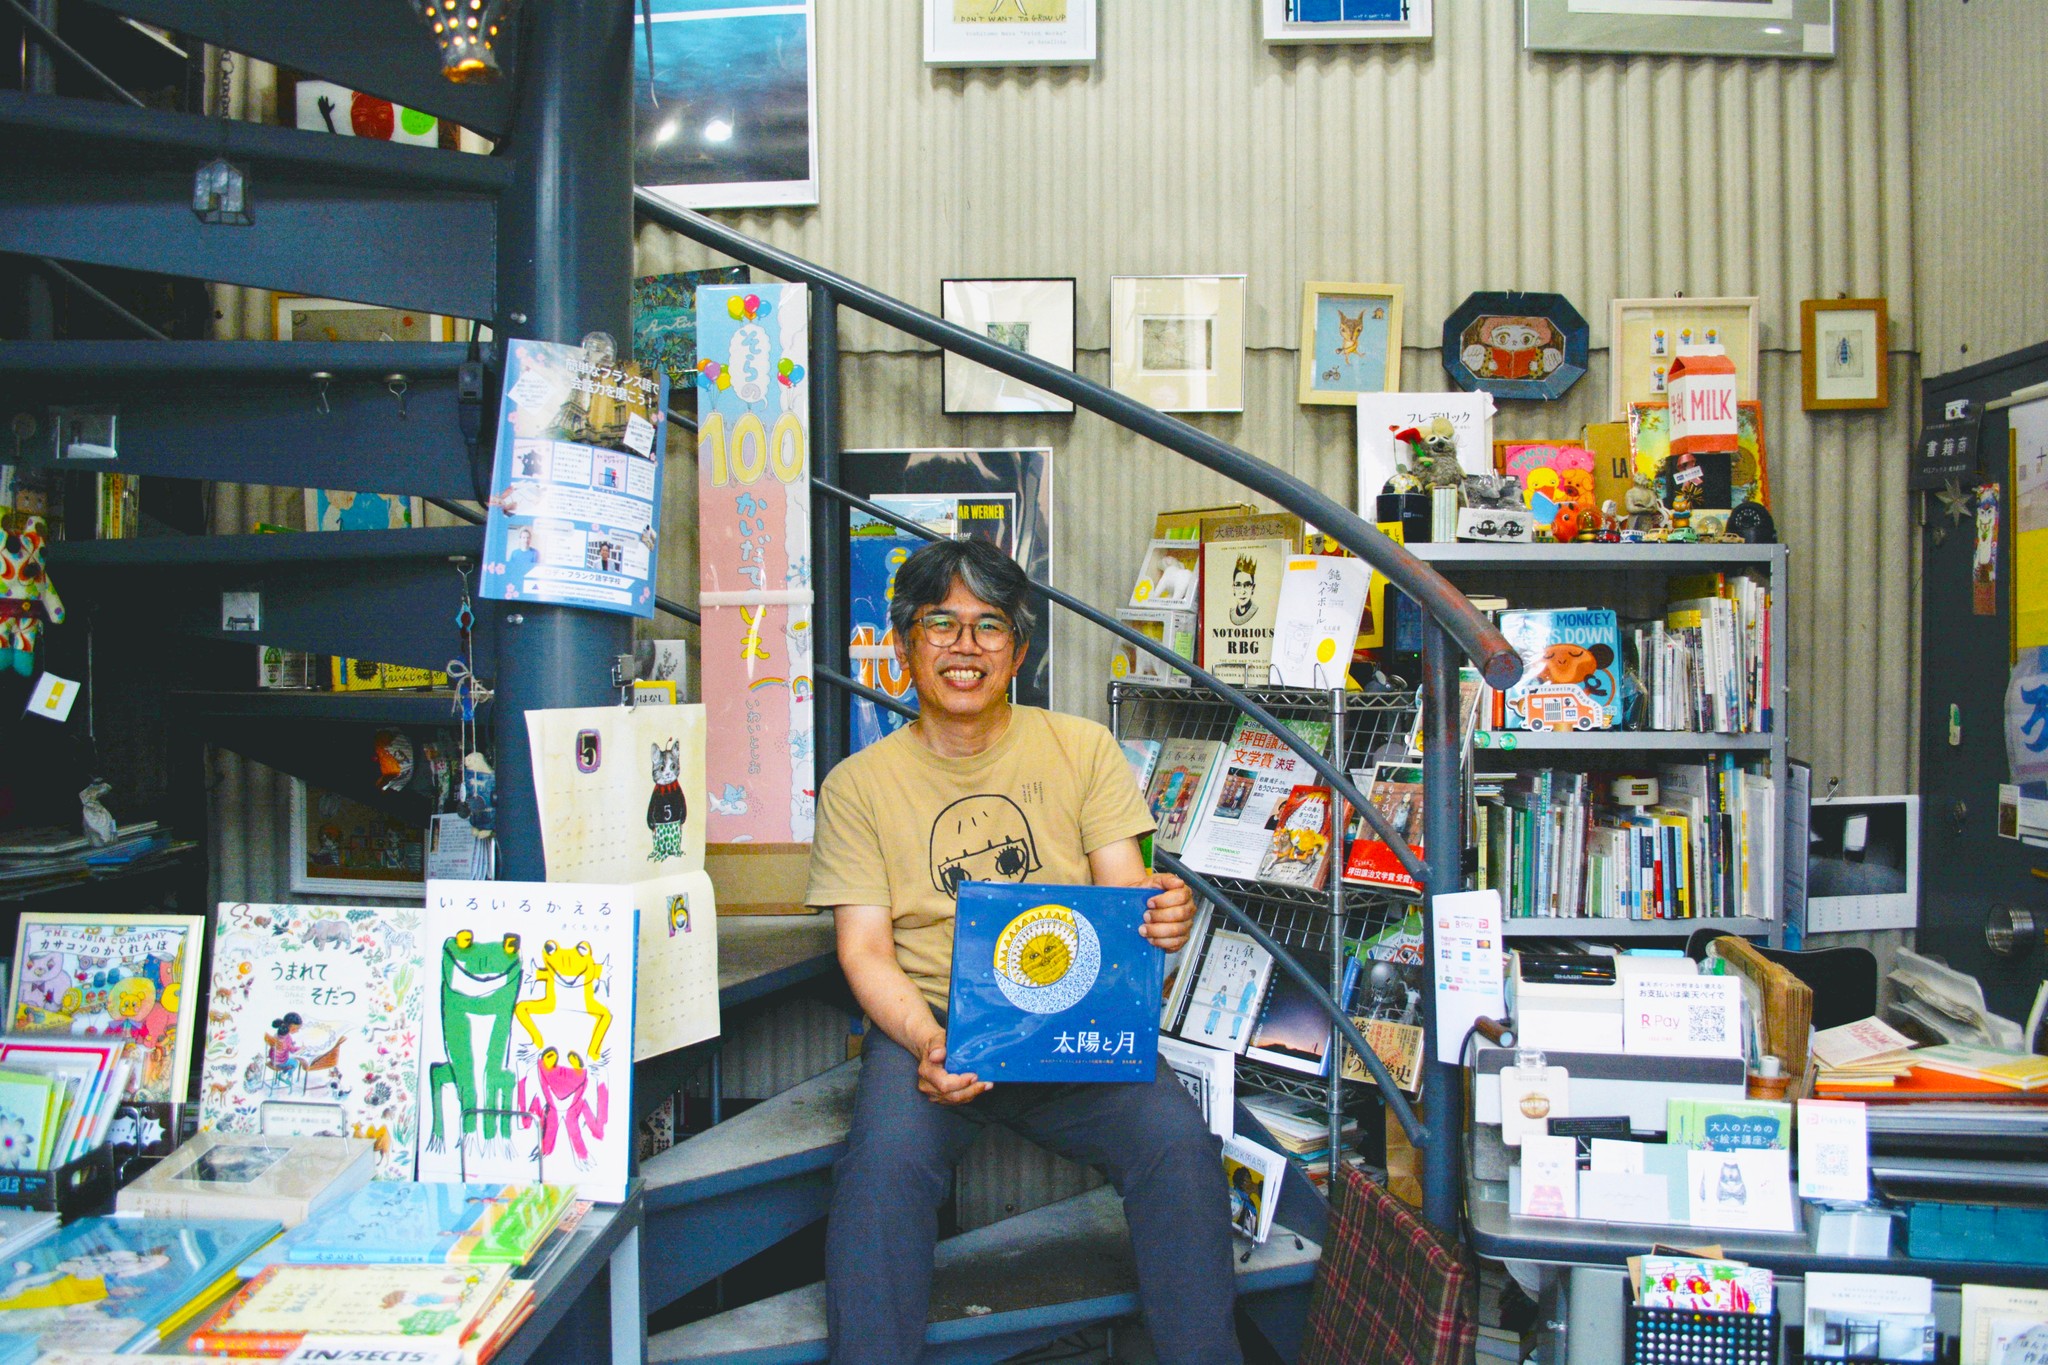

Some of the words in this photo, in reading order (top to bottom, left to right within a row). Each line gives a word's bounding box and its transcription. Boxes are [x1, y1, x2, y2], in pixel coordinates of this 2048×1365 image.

[1031, 14, 1053, 22] GROW
[739, 330, 762, 398] そらの
[565, 358, 660, 396] 簡単なフランス語で
[1691, 389, 1733, 421] MILK
[698, 411, 805, 488] 100
[1612, 457, 1628, 478] LA
[971, 505, 1005, 519] WERNER
[1556, 612, 1611, 627] MONKEY
[1213, 628, 1274, 638] NOTORIOUS
[1565, 627, 1614, 644] DOWN
[1227, 641, 1259, 654] RBG
[580, 732, 597, 769] 5
[1231, 748, 1275, 768] 文学賞
[1274, 757, 1296, 772] 決定
[663, 805, 671, 820] 5
[440, 896, 613, 916] いろいろかえる
[670, 896, 689, 931] 6
[44, 930, 67, 938] THE
[72, 930, 106, 943] CABIN
[111, 932, 167, 945] COMPANY
[40, 939, 168, 956] カサコソのかくれんぼ
[271, 962, 328, 981] うまれて
[311, 986, 356, 1006] そだつ
[1640, 990, 1725, 999] お支払いは楽天ペイで
[1655, 1014, 1680, 1029] Pay
[1051, 1030, 1135, 1056] 太陽と月
[1709, 1121, 1773, 1133] 大人のための
[297, 1349, 426, 1363] IN/SECTS
